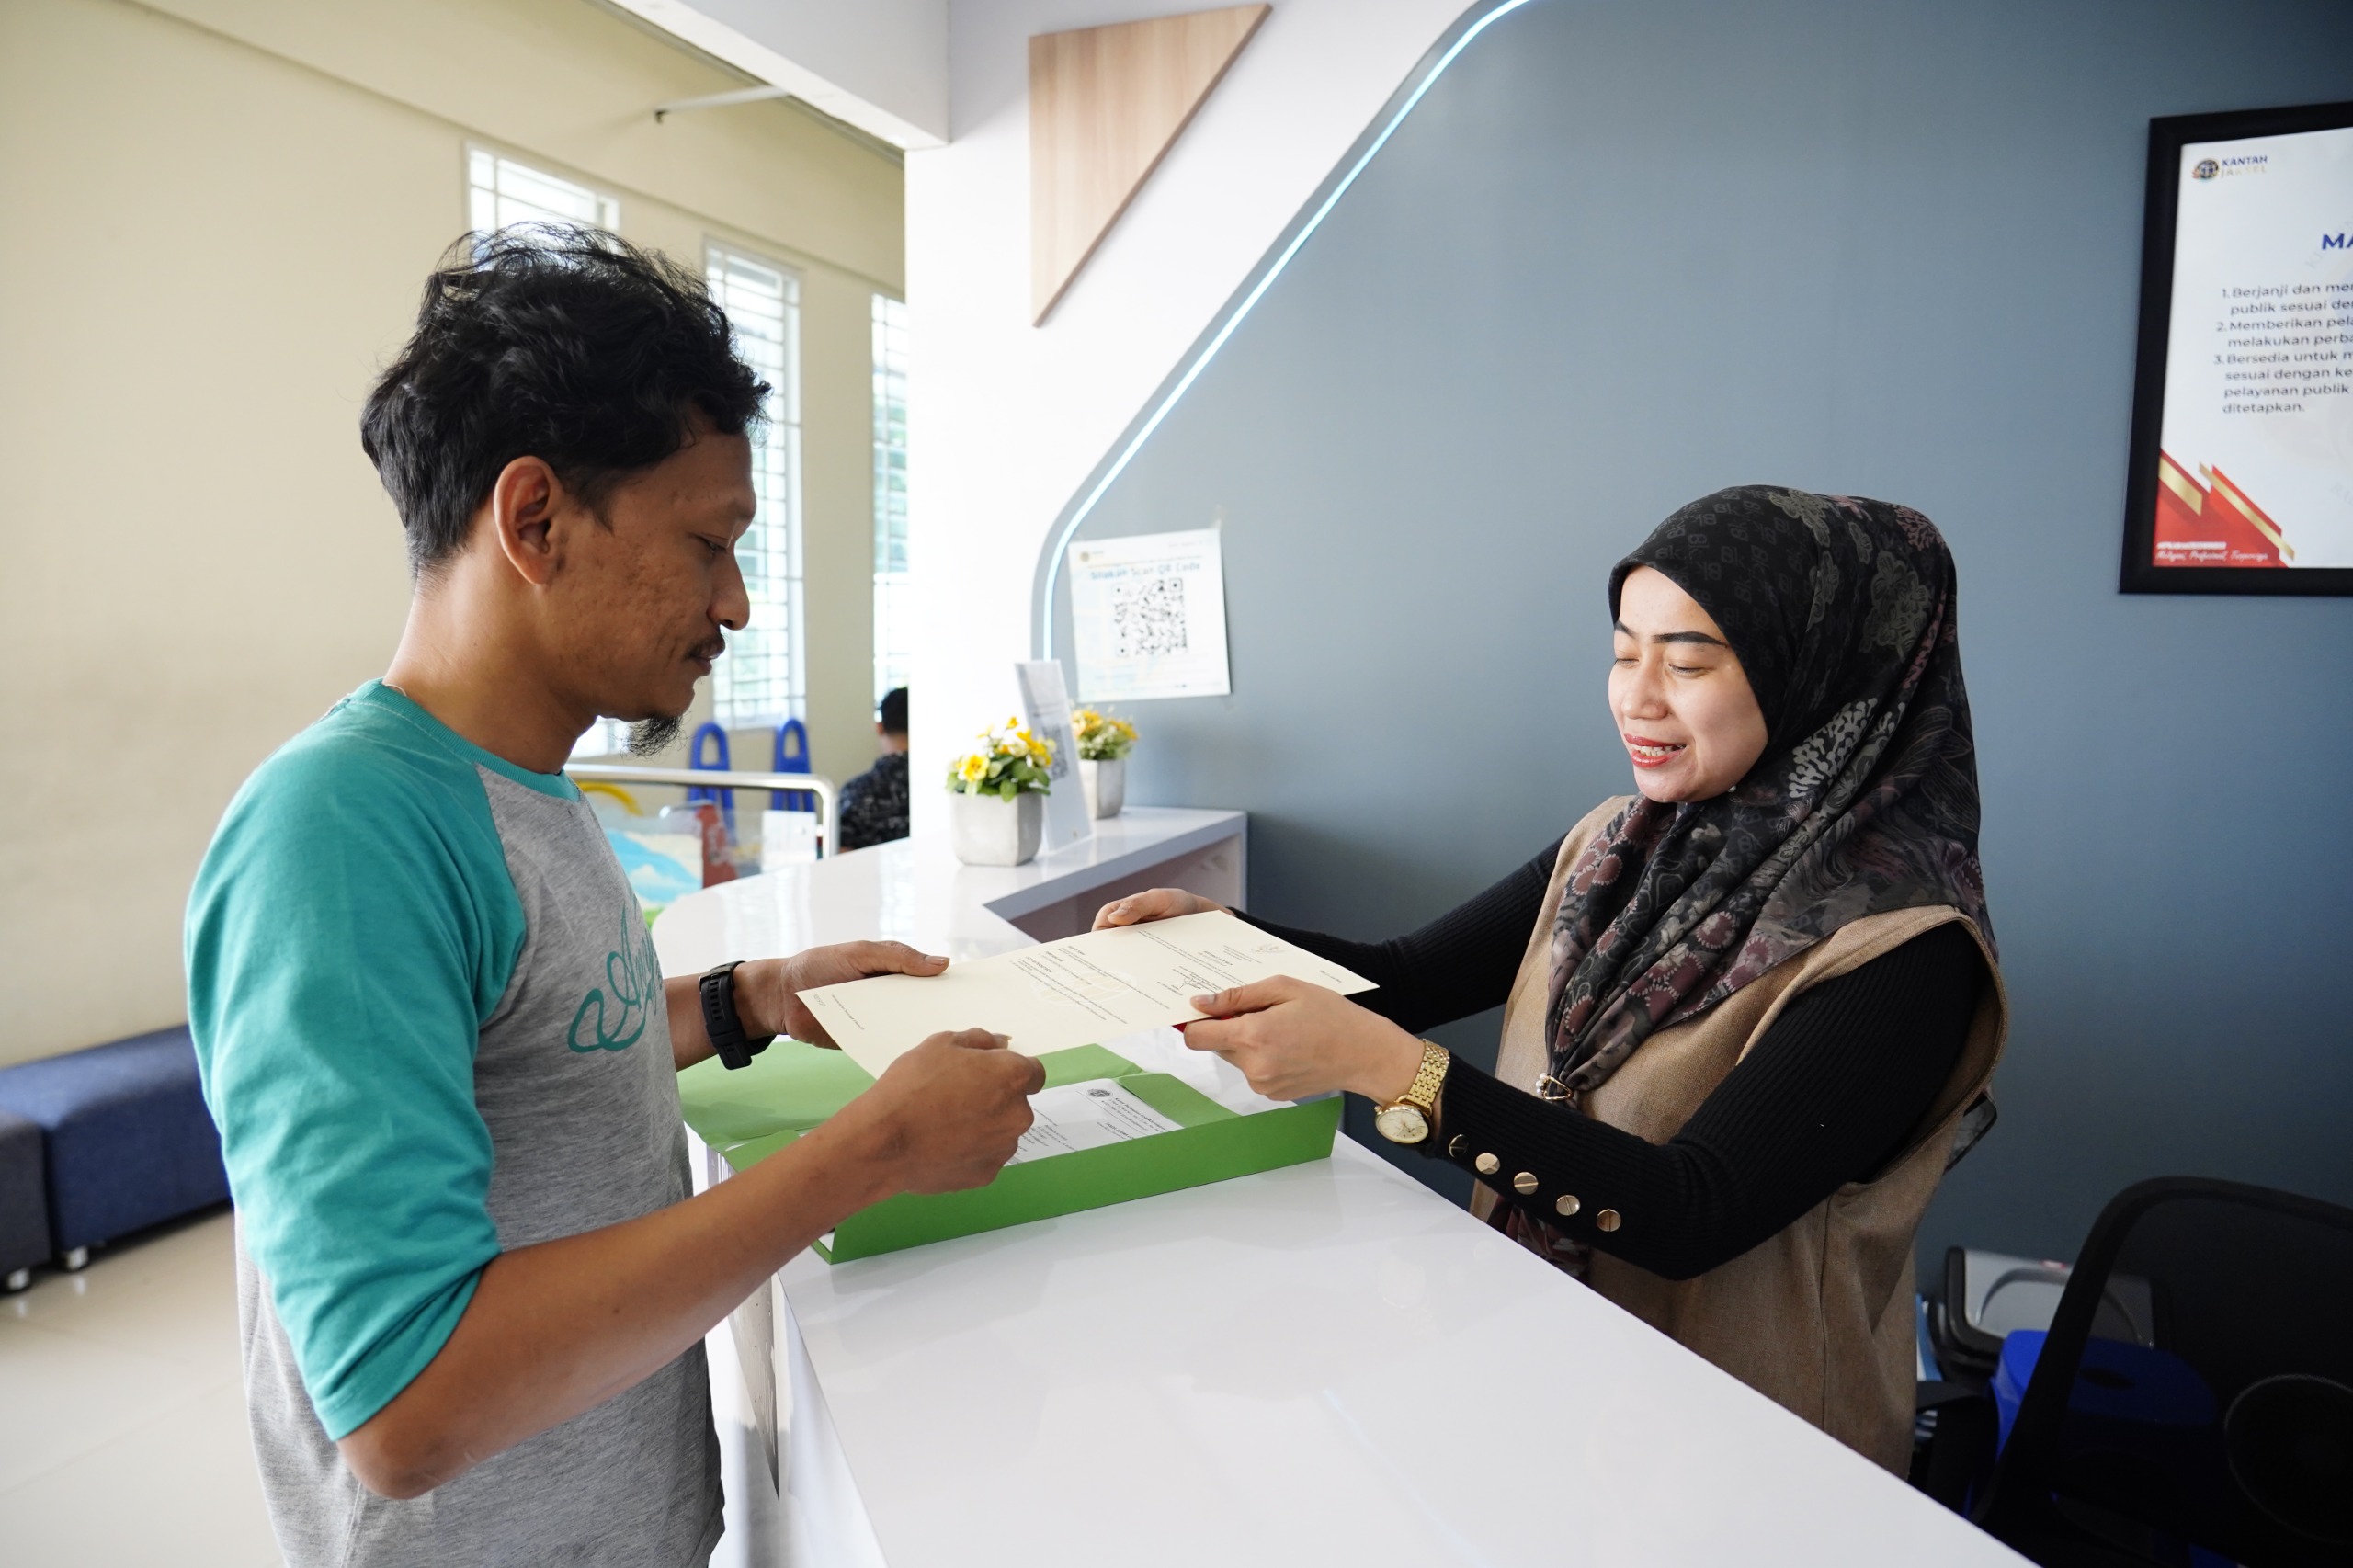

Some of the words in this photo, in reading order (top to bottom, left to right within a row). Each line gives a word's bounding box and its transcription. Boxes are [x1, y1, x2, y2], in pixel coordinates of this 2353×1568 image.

[2233, 284, 2289, 299] Berjanji
[2292, 284, 2321, 295] dan
[2230, 302, 2277, 315] publik
[2280, 300, 2327, 312] sesuai
[2229, 318, 2322, 331] Memberikan
[2227, 335, 2310, 347] melakukan
[2227, 352, 2290, 364] Bersedia
[2294, 350, 2338, 362] untuk
[2225, 369, 2270, 381] sesuai
[2274, 369, 2330, 381] dengan
[2224, 386, 2299, 399] pelayanan
[2303, 383, 2349, 396] publik
[2222, 402, 2305, 415] ditetapkan.
